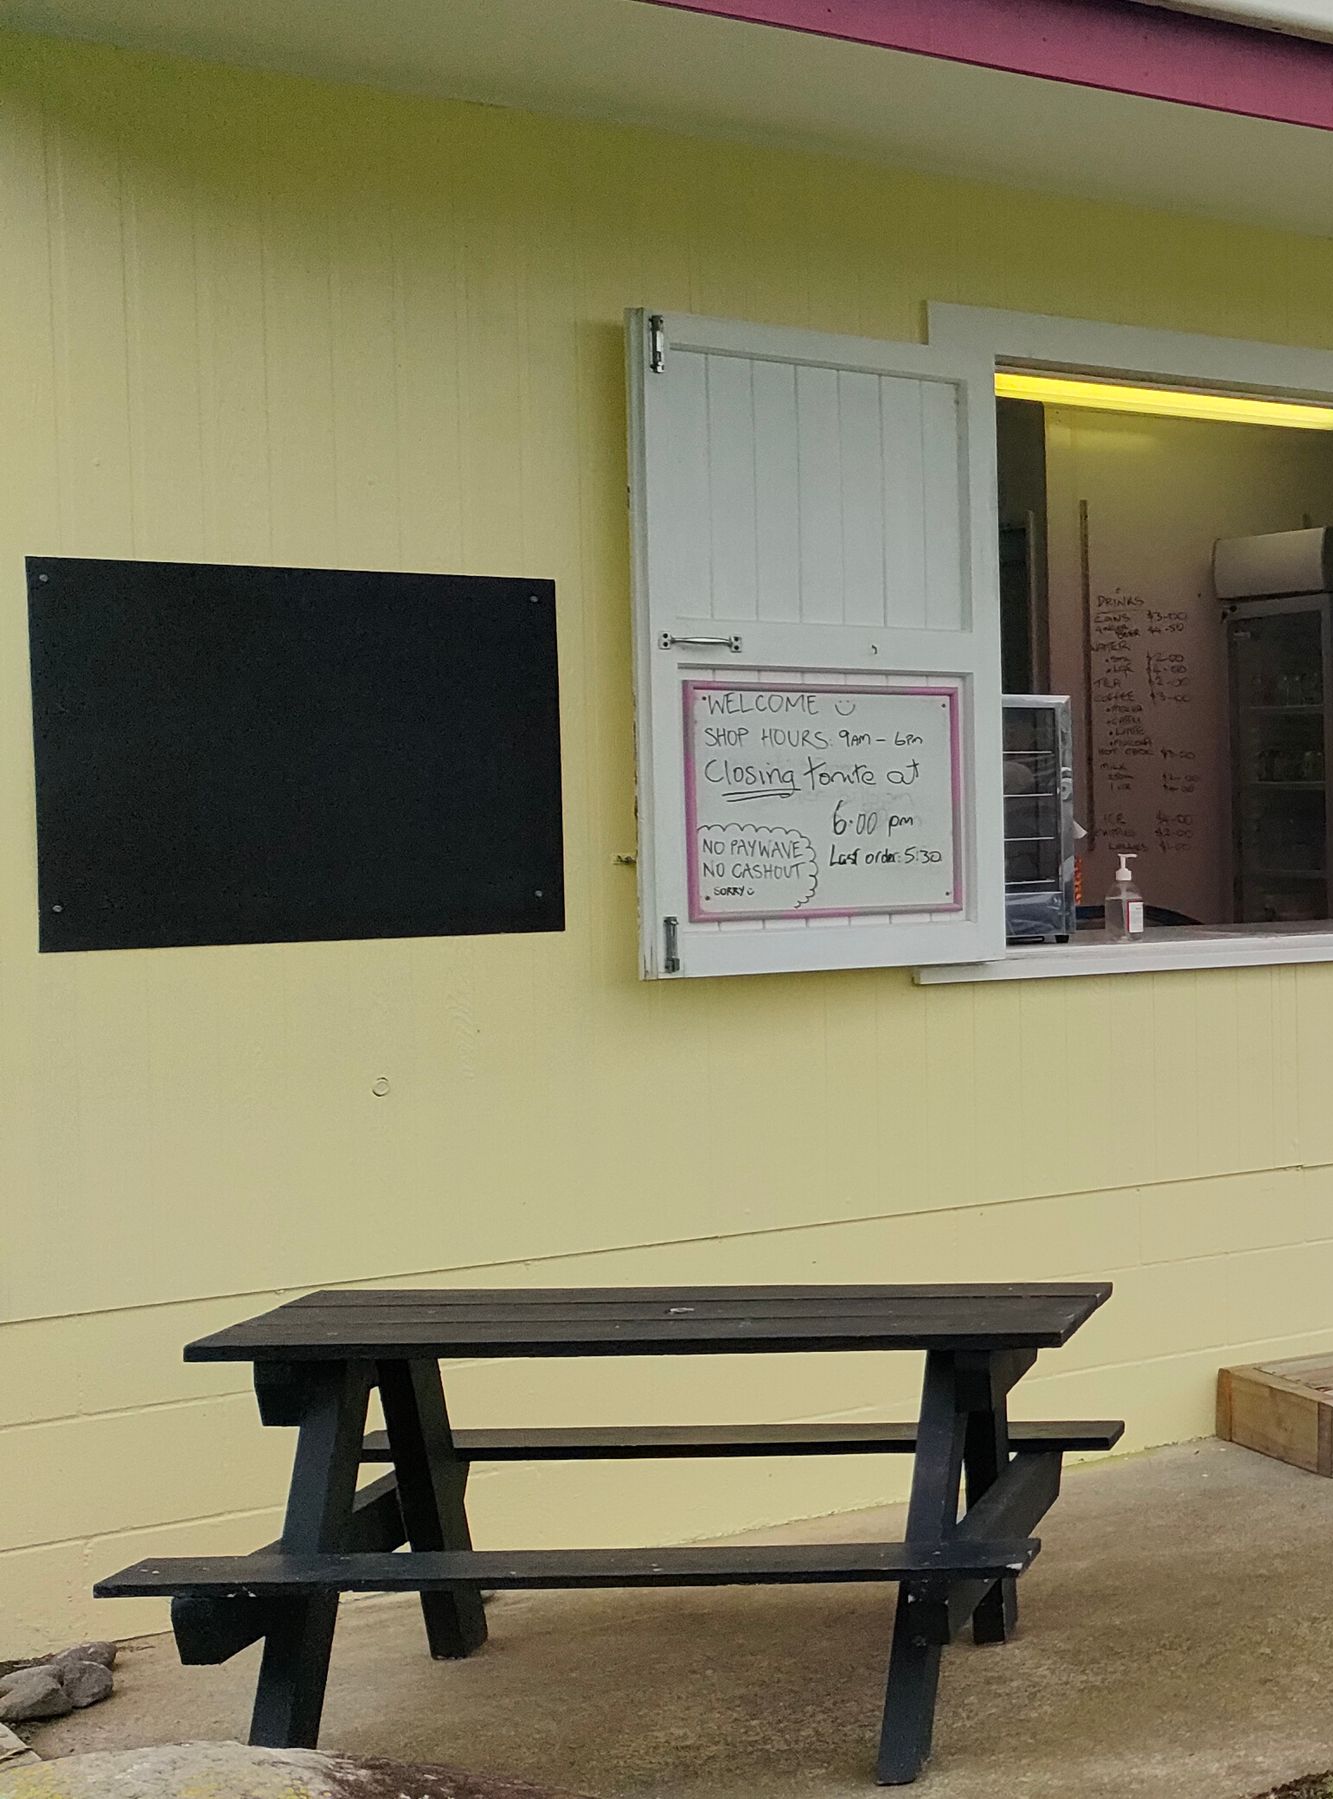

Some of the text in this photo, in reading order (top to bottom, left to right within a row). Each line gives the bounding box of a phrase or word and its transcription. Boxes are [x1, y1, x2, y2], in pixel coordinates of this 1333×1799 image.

[1097, 595, 1144, 607] DRINKS
[707, 694, 819, 715] WELCOME
[704, 728, 749, 747] SHOP
[705, 759, 795, 794] Closing
[886, 760, 920, 785] at
[702, 839, 803, 859] NO PAYWAVE
[702, 861, 803, 879] NO CASHOUT
[714, 886, 744, 896] SORRY
